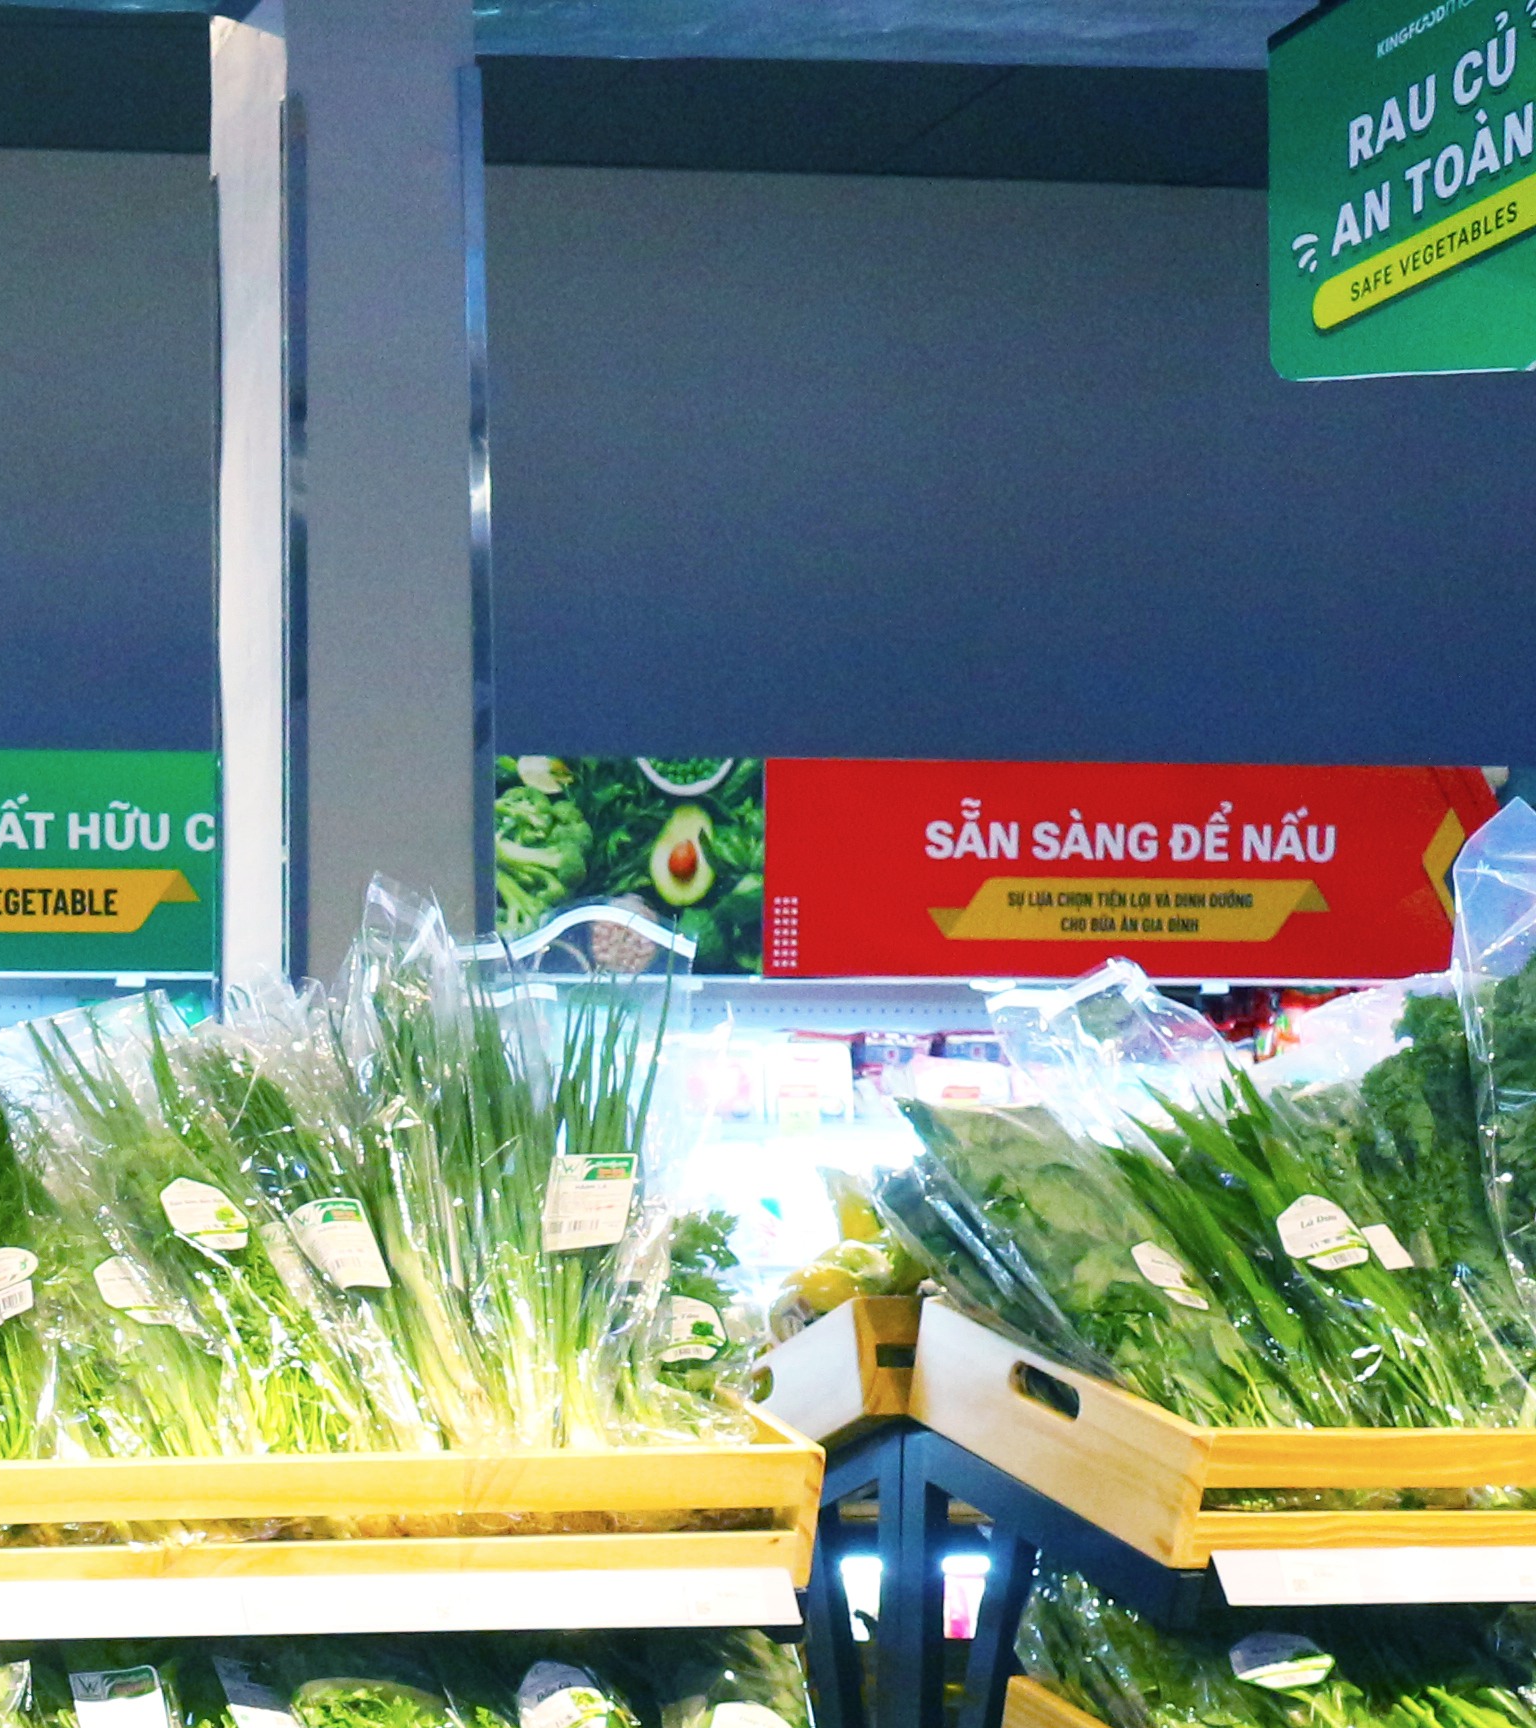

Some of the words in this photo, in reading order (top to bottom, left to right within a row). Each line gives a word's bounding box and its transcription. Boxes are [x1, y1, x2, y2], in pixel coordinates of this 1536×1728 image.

[1348, 74, 1436, 169] RAU
[1453, 11, 1517, 107] CỦ
[1331, 180, 1391, 257] AN
[1405, 101, 1534, 214] TOÀN
[1350, 267, 1393, 302] SAFE
[1399, 201, 1519, 278] VEGETABLES
[68, 800, 170, 852] HỮU
[184, 812, 215, 852] C
[925, 797, 1020, 860] SẴN
[1032, 808, 1158, 862] SÀNG
[1168, 801, 1231, 862] ĐỂ
[1241, 806, 1337, 863] NẤU
[1061, 917, 1087, 932] CHO
